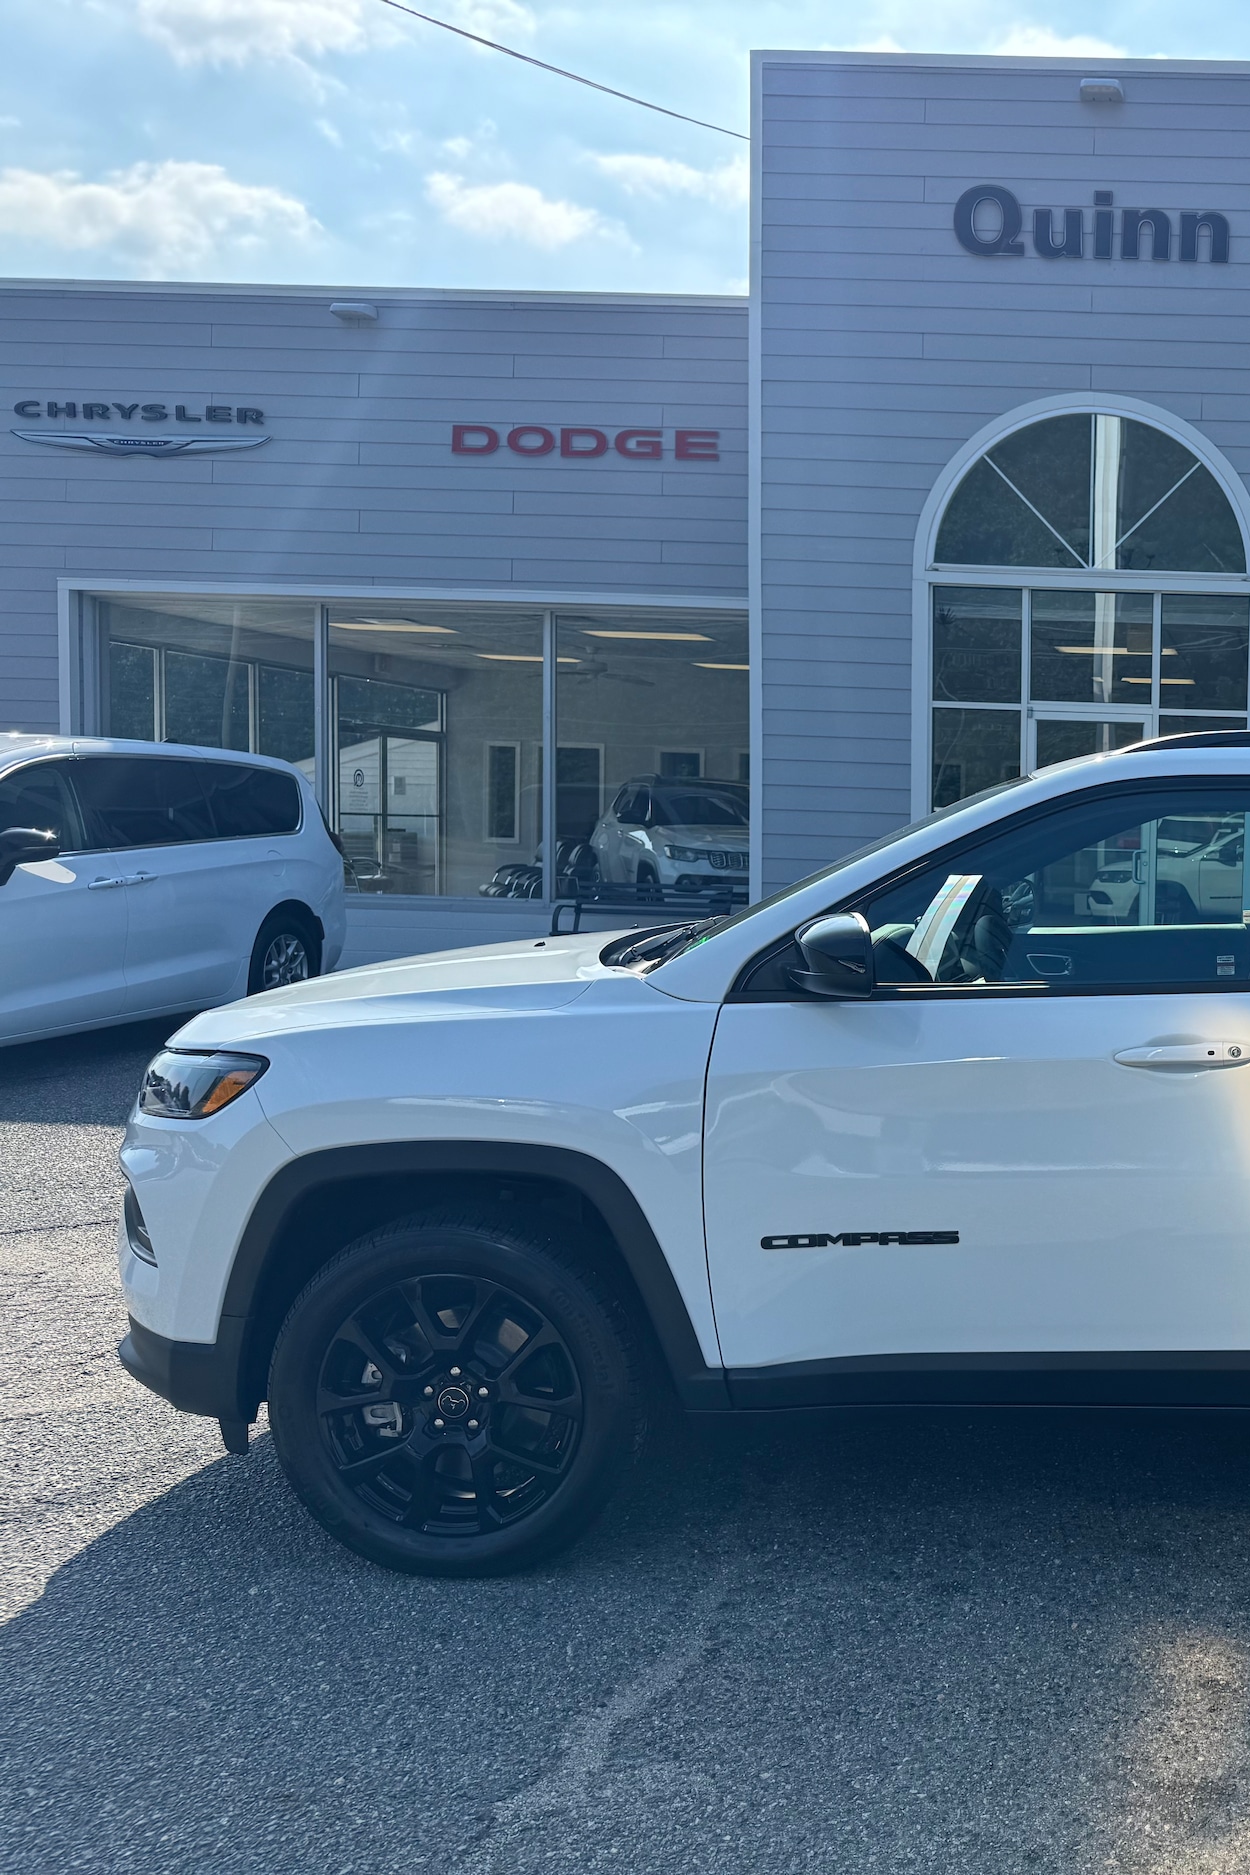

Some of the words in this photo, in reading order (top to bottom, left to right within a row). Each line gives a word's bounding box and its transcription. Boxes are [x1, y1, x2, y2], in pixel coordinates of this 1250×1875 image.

[953, 184, 1230, 263] Quinn
[13, 400, 265, 425] CHRYSLER
[451, 424, 720, 462] DODGE
[760, 1230, 960, 1250] COMPASS
